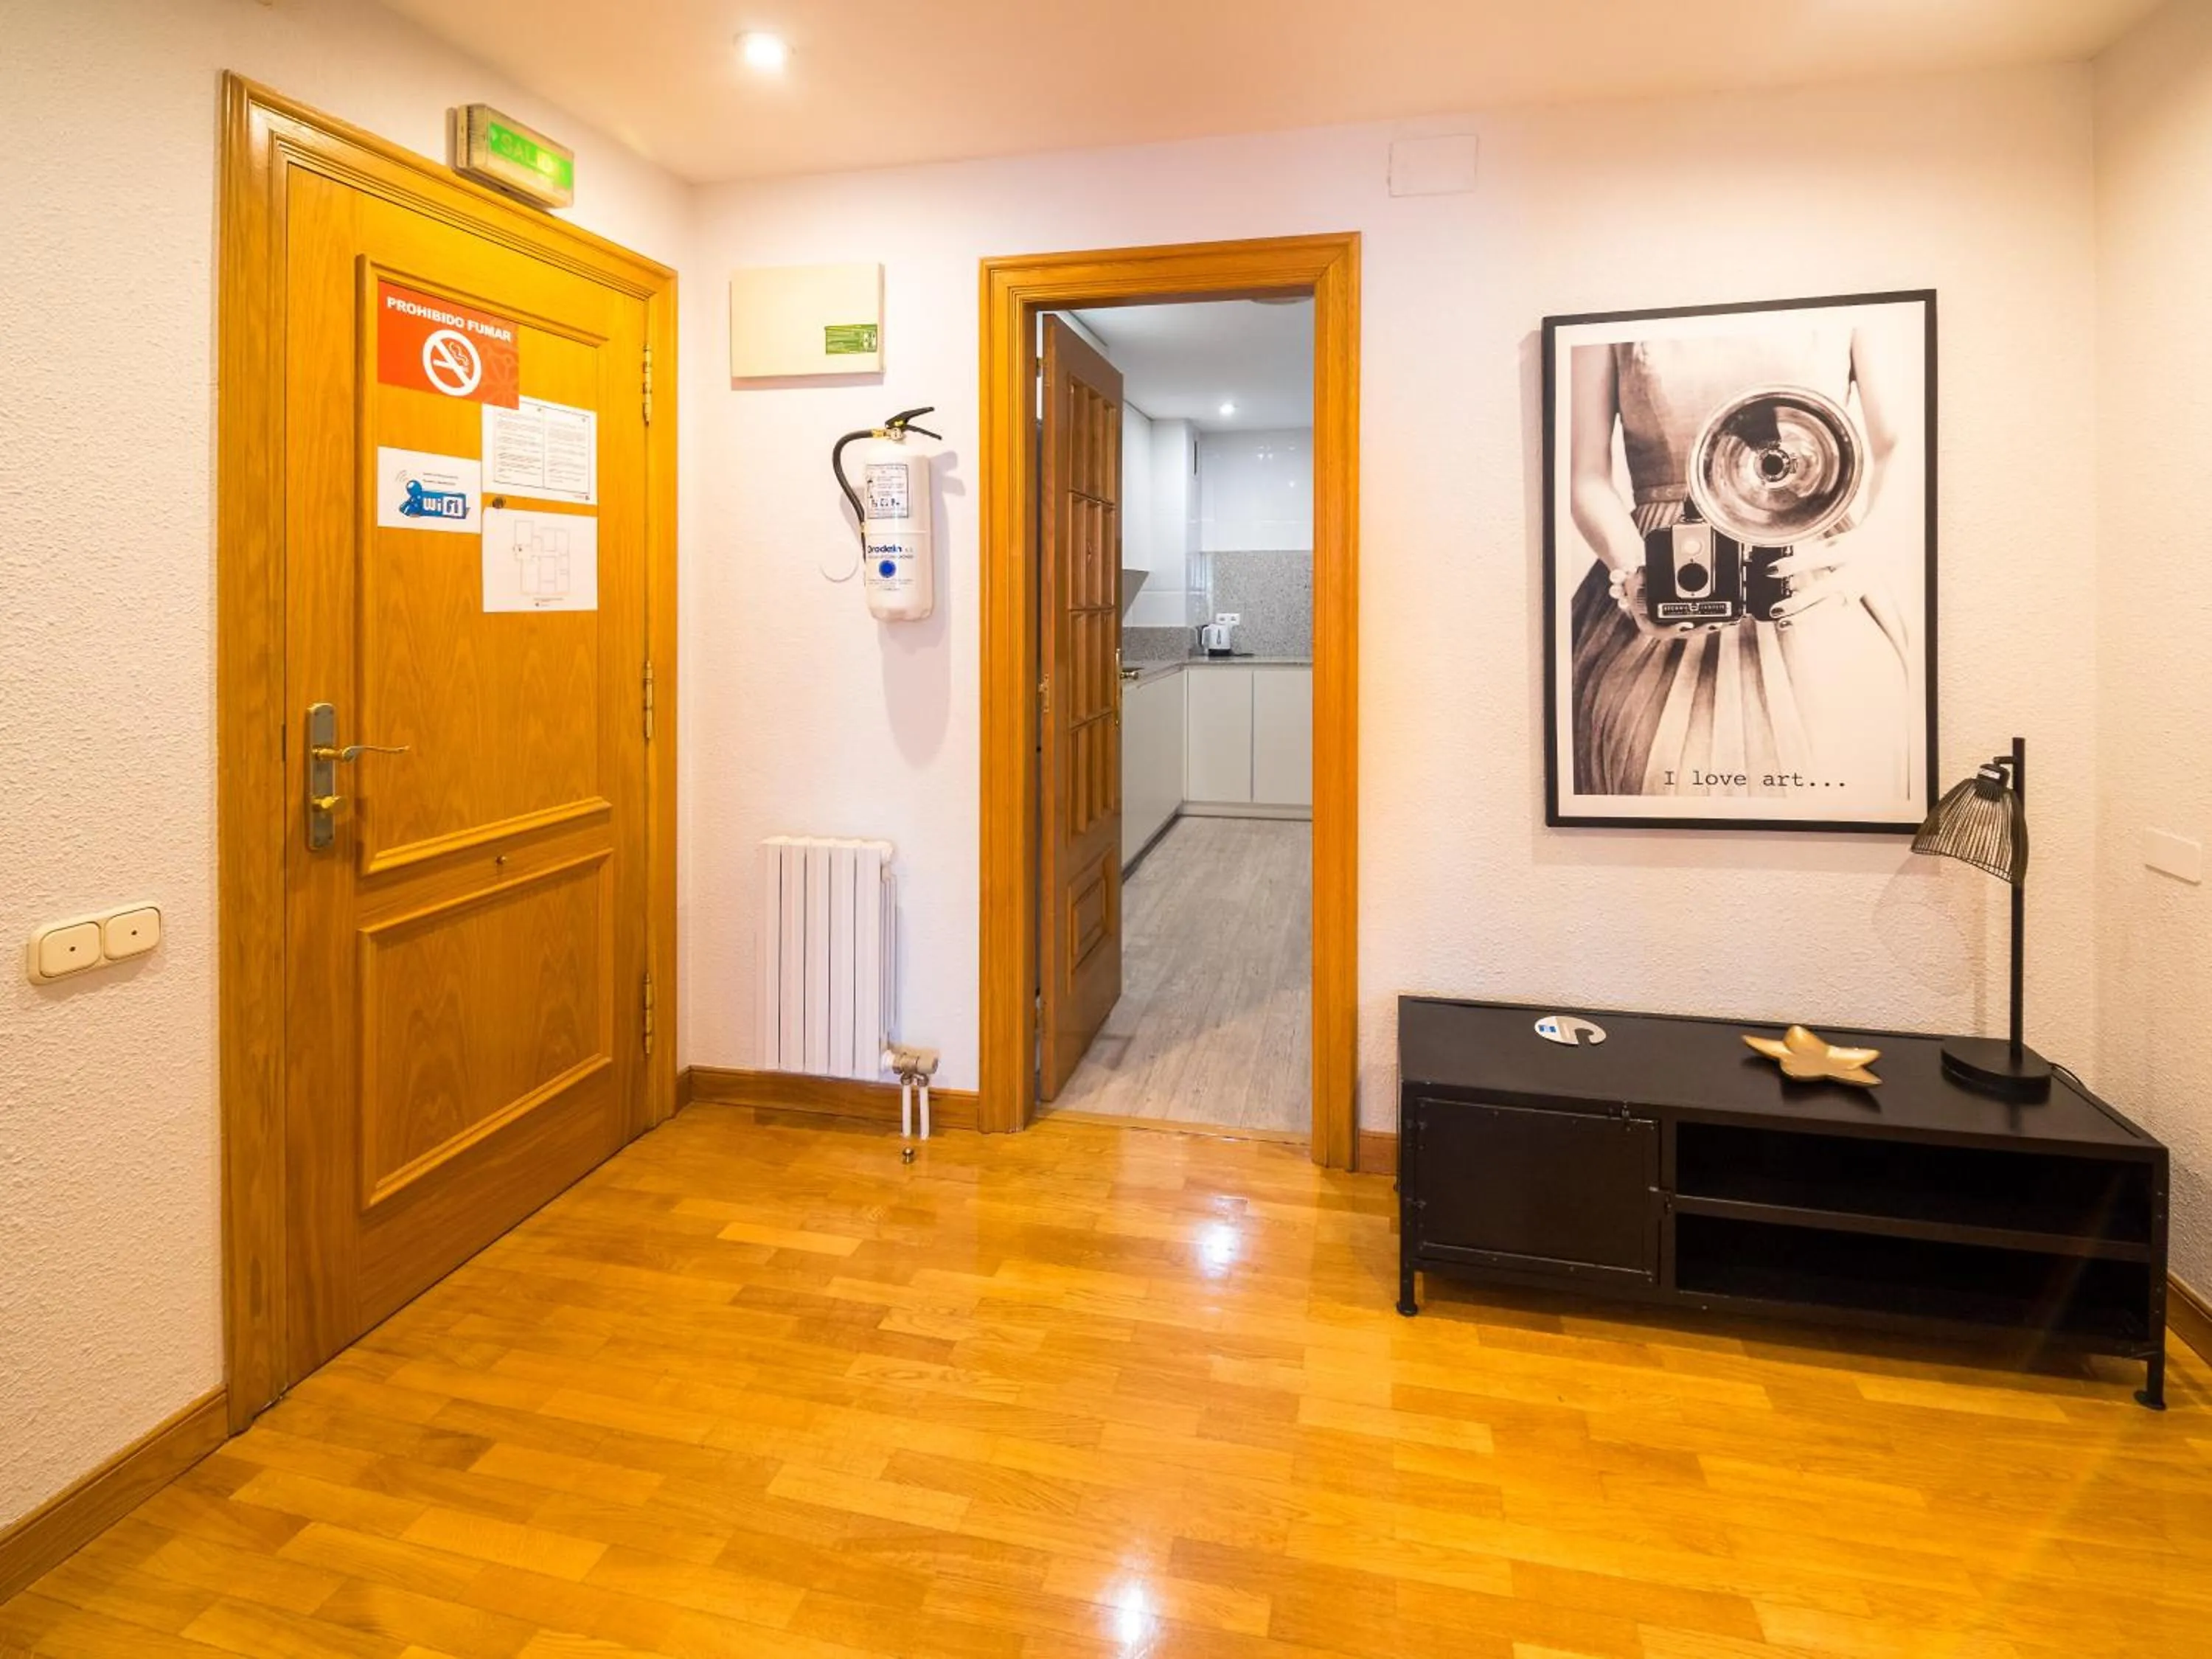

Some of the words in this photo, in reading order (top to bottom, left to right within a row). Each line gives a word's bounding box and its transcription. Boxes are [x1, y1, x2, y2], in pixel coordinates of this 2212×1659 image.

[501, 133, 562, 178] SALID
[386, 296, 465, 329] PROHIBIDO
[467, 319, 511, 342] FUMAR
[1664, 771, 1674, 785] I
[1692, 771, 1747, 786] love
[1763, 772, 1846, 787] art...
